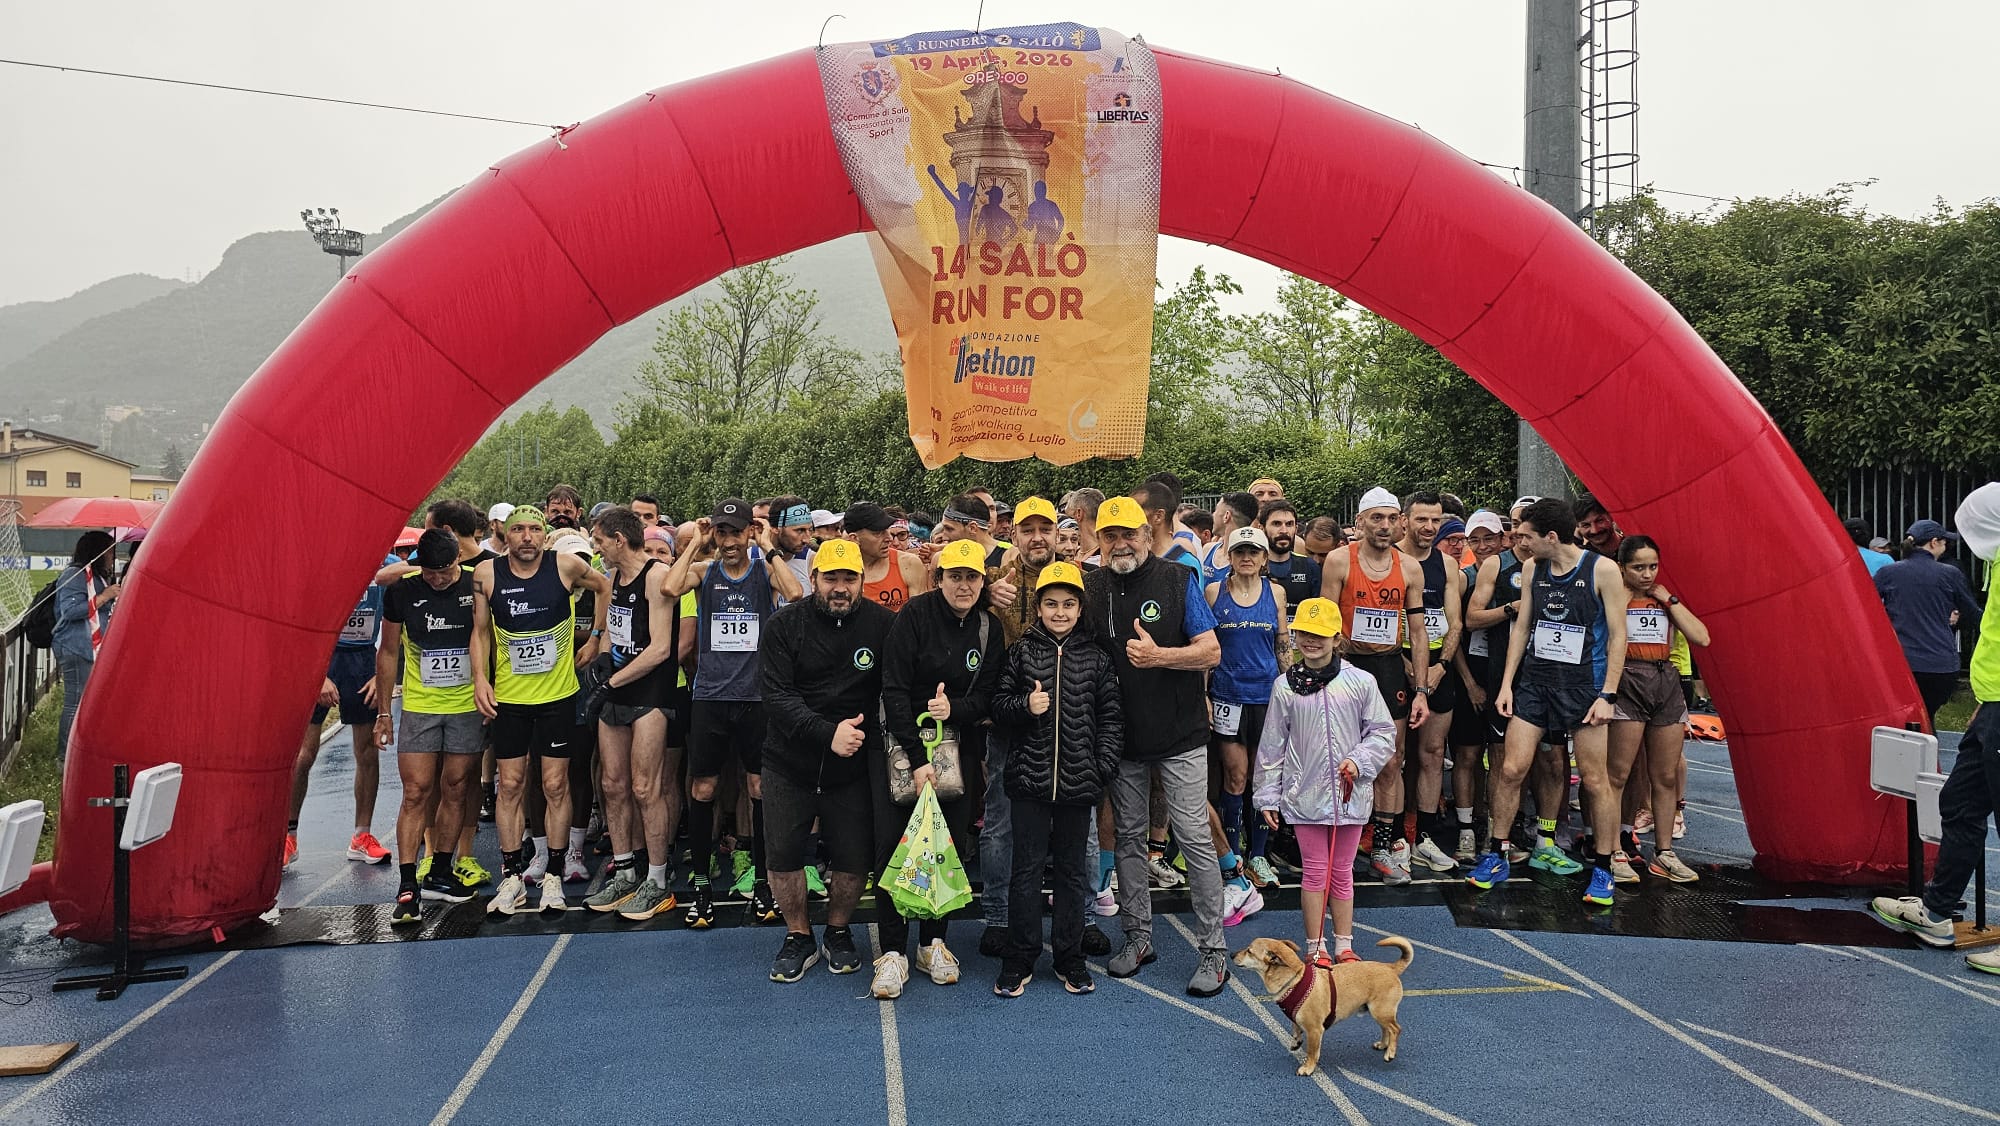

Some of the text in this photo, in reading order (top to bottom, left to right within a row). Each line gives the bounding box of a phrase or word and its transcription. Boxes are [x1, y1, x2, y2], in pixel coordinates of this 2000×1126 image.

[917, 36, 987, 51] RUNNERS
[1018, 31, 1064, 48] SALÒ
[910, 56, 932, 71] 19
[1015, 50, 1074, 68] 2026
[1097, 110, 1149, 121] LIBERTAS
[869, 126, 894, 140] Sport
[979, 231, 1088, 278] SALÒ
[932, 284, 1084, 325] RUN FOR
[969, 331, 1041, 343] ONDAZIONE
[975, 381, 1029, 394] Walk of life
[977, 418, 1023, 433] walking
[1016, 432, 1025, 442] 6
[1029, 432, 1067, 446] Luglio
[720, 622, 748, 635] 318
[1366, 616, 1389, 630] 101
[1640, 616, 1658, 628] 94
[1552, 631, 1562, 643] 3
[517, 643, 546, 659] 225
[431, 657, 460, 670] 212
[1215, 704, 1231, 718] 79
